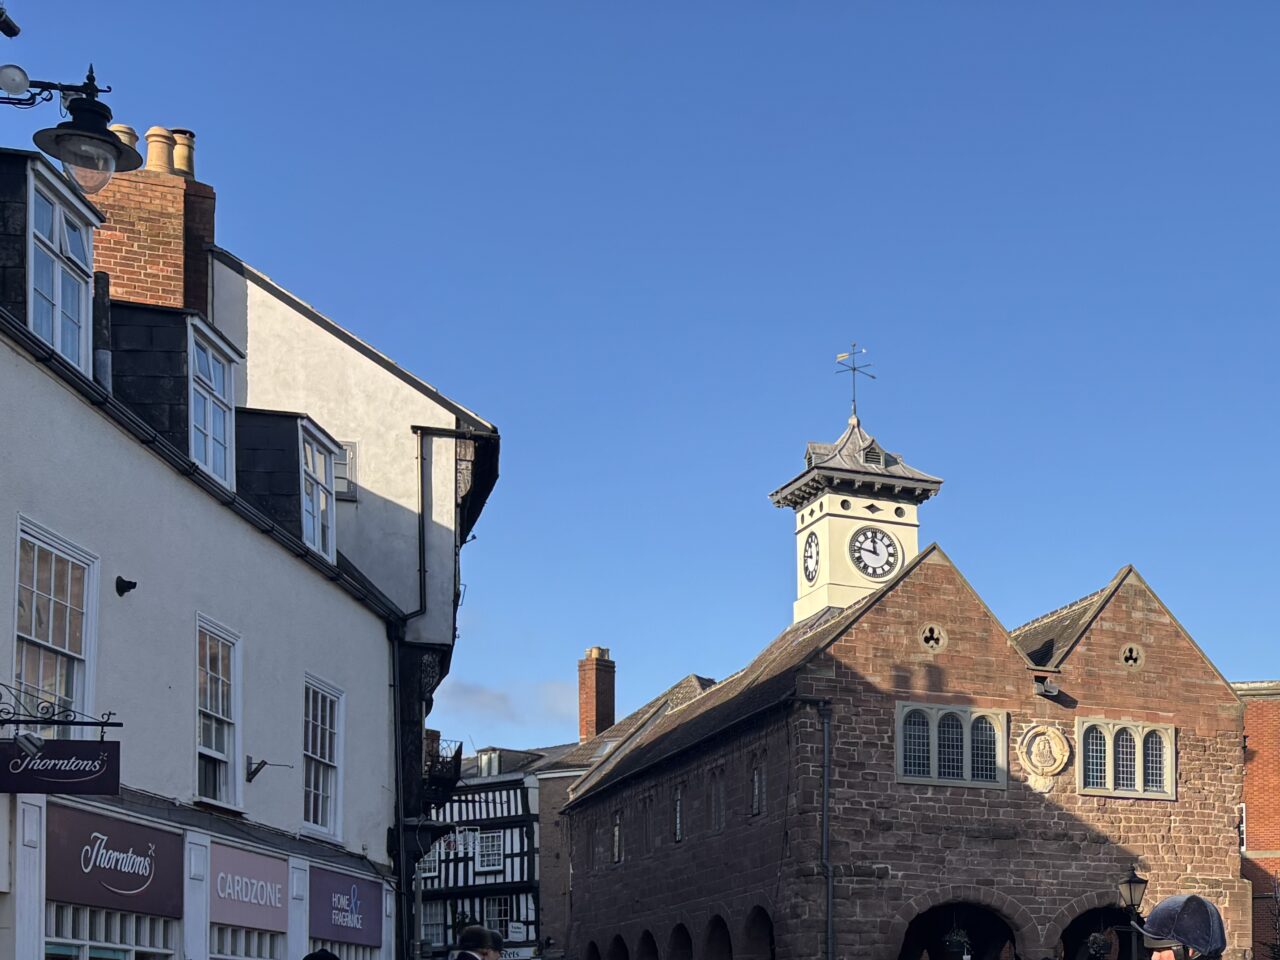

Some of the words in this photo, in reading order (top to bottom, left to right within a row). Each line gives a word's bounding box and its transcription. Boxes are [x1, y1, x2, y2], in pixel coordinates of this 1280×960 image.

[9, 752, 102, 774] Thorntons
[81, 832, 151, 877] Thorntons
[217, 871, 282, 907] CARDZONE
[332, 892, 350, 910] HOME
[332, 910, 363, 929] FRAGRANCE
